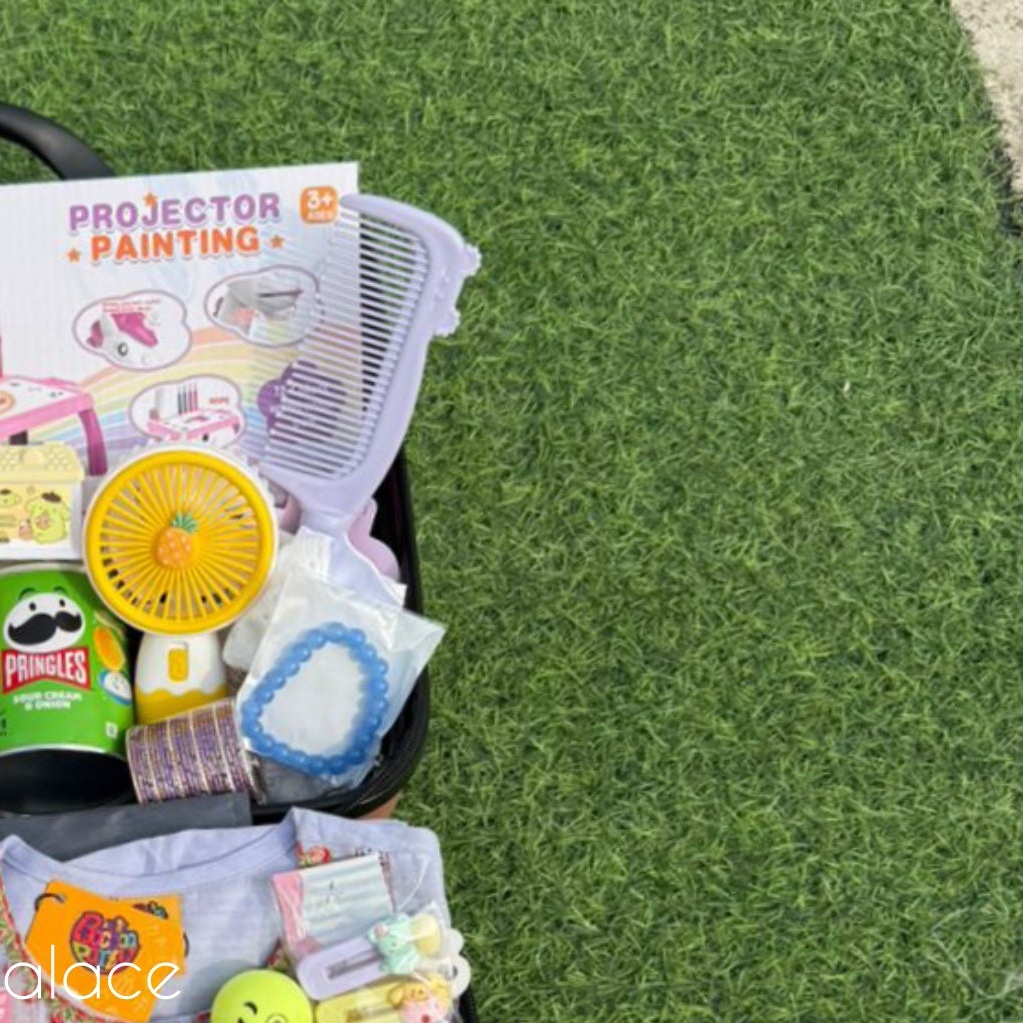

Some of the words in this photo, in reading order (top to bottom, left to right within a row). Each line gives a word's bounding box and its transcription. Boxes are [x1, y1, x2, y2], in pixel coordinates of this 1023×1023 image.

[69, 192, 281, 232] PROJECTOR
[306, 189, 333, 210] 3+
[90, 225, 261, 263] PAINTING
[5, 650, 88, 690] PRINGLES
